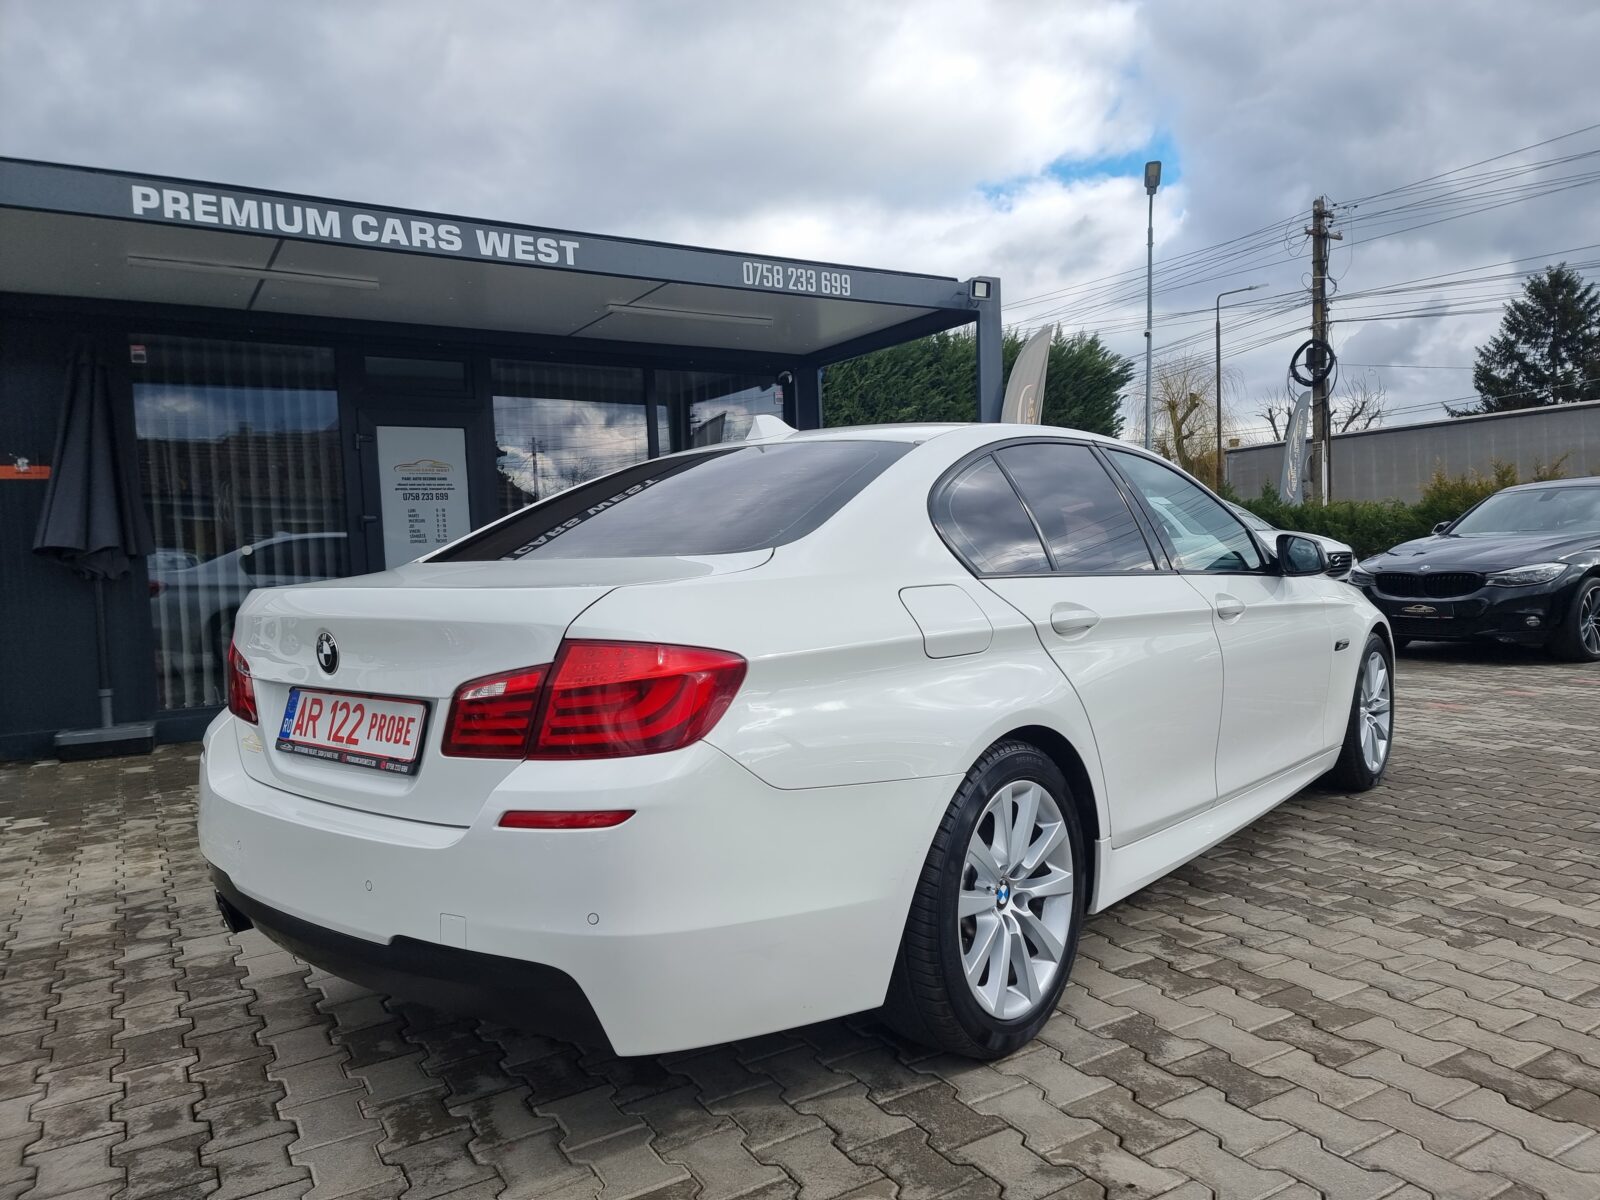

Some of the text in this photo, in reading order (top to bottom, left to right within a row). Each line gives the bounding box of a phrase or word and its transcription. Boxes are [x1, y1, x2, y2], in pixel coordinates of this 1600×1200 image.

[131, 185, 580, 267] PREMIUM CARS WEST
[742, 261, 851, 296] 0758 233 699
[402, 492, 449, 501] 0758 233 699
[282, 717, 294, 734] RO
[292, 696, 416, 746] AR 122 PROBE
